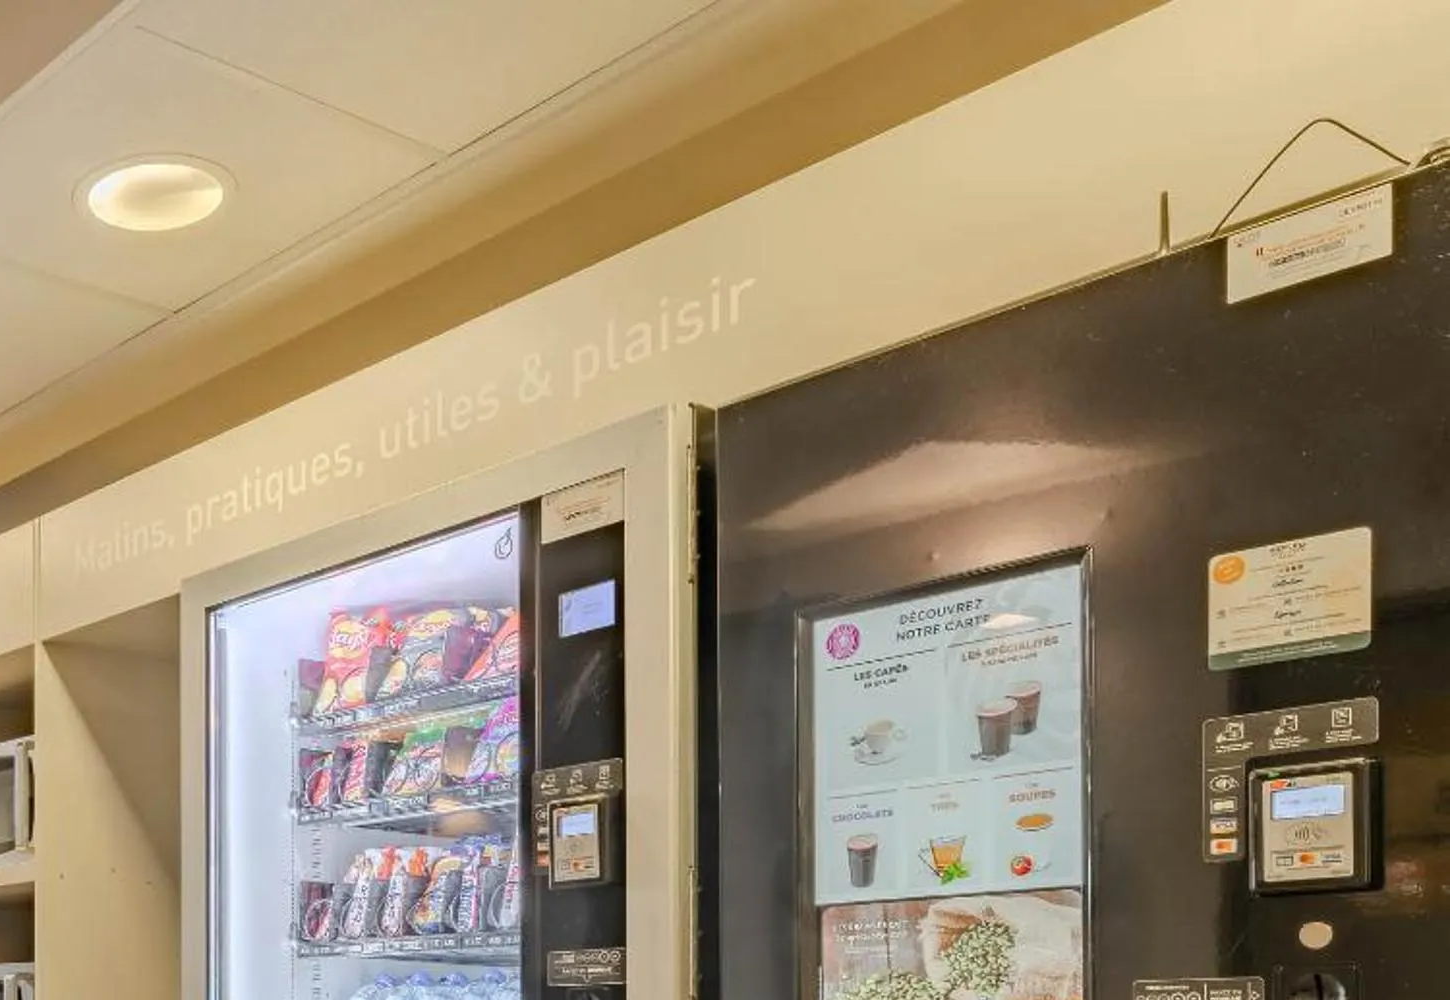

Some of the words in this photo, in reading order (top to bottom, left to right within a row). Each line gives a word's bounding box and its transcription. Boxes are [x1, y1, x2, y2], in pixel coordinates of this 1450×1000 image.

[74, 516, 176, 578] Malins,
[186, 442, 365, 546] pratiques,
[379, 381, 500, 460] utiles
[518, 352, 553, 405] &
[572, 275, 757, 401] plaisir
[899, 598, 985, 626] DÉCOUVREZ
[896, 625, 941, 643] NOTRE
